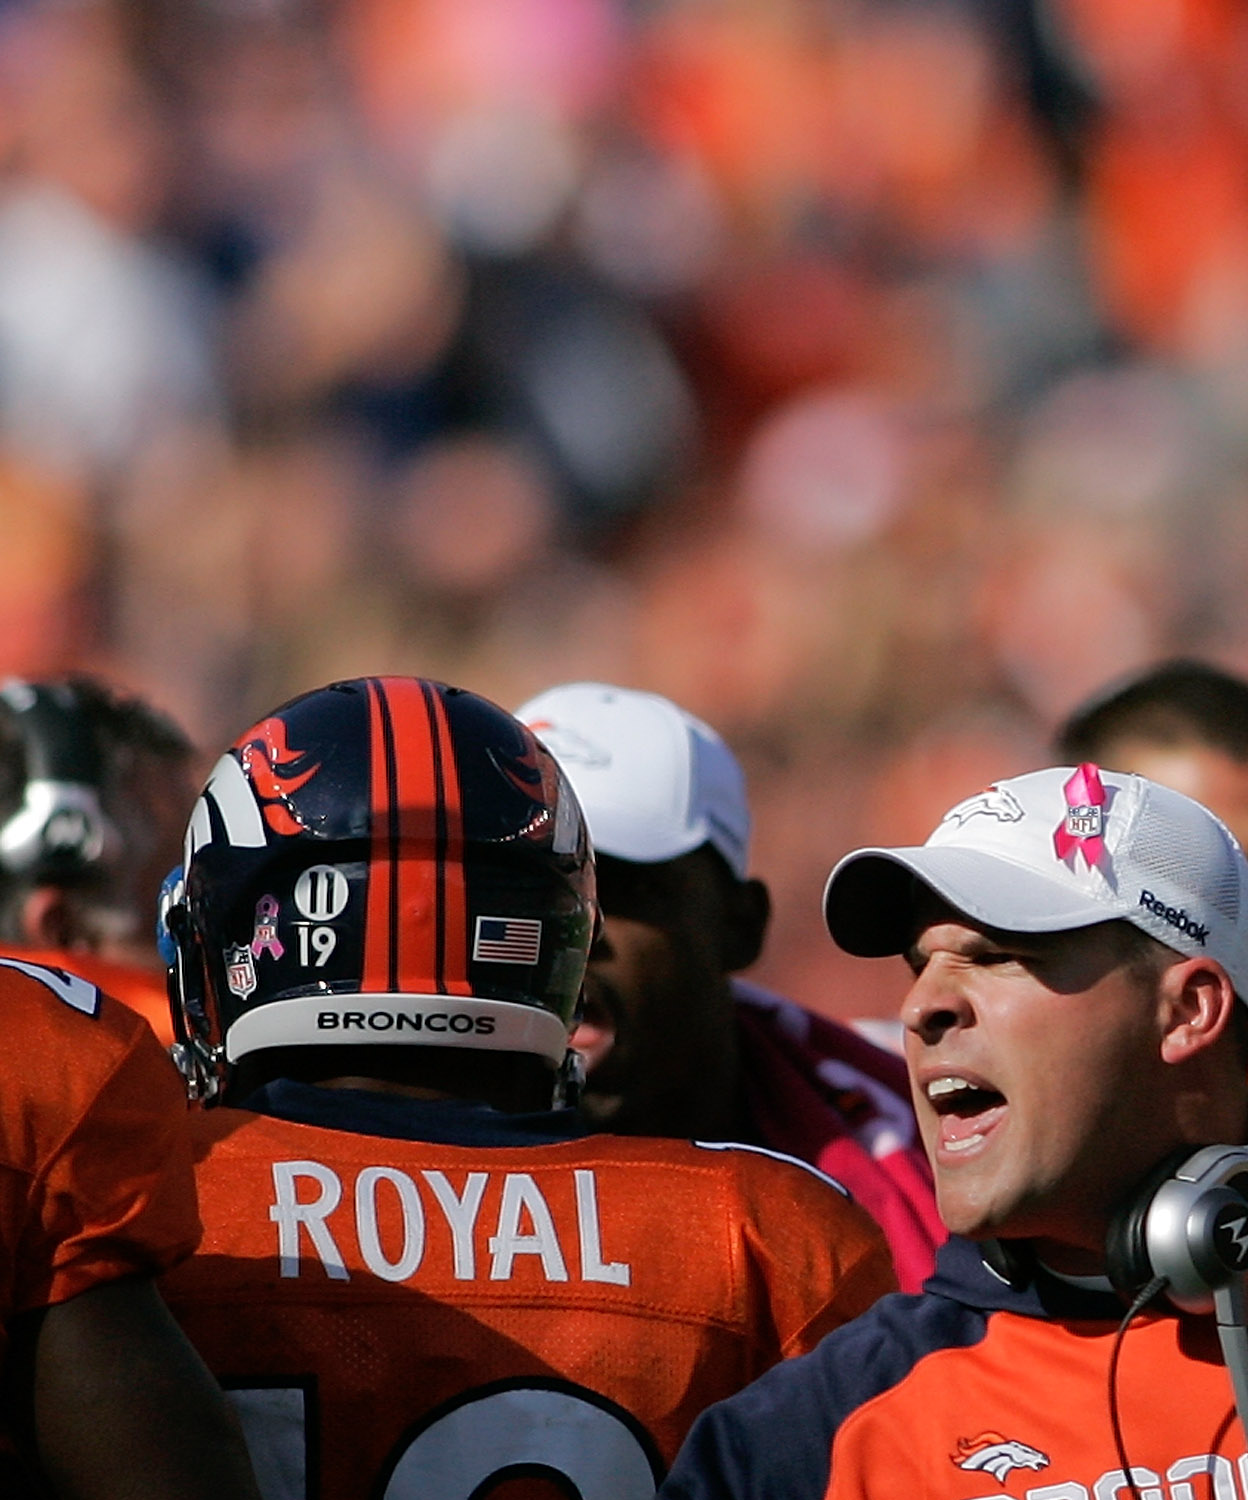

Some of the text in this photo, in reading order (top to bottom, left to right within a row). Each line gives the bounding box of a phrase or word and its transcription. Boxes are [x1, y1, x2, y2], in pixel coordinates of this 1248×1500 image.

[1139, 890, 1211, 947] Reebok
[297, 926, 337, 968] 19
[317, 1011, 496, 1035] BRONCOS
[269, 1159, 631, 1287] ROYAL
